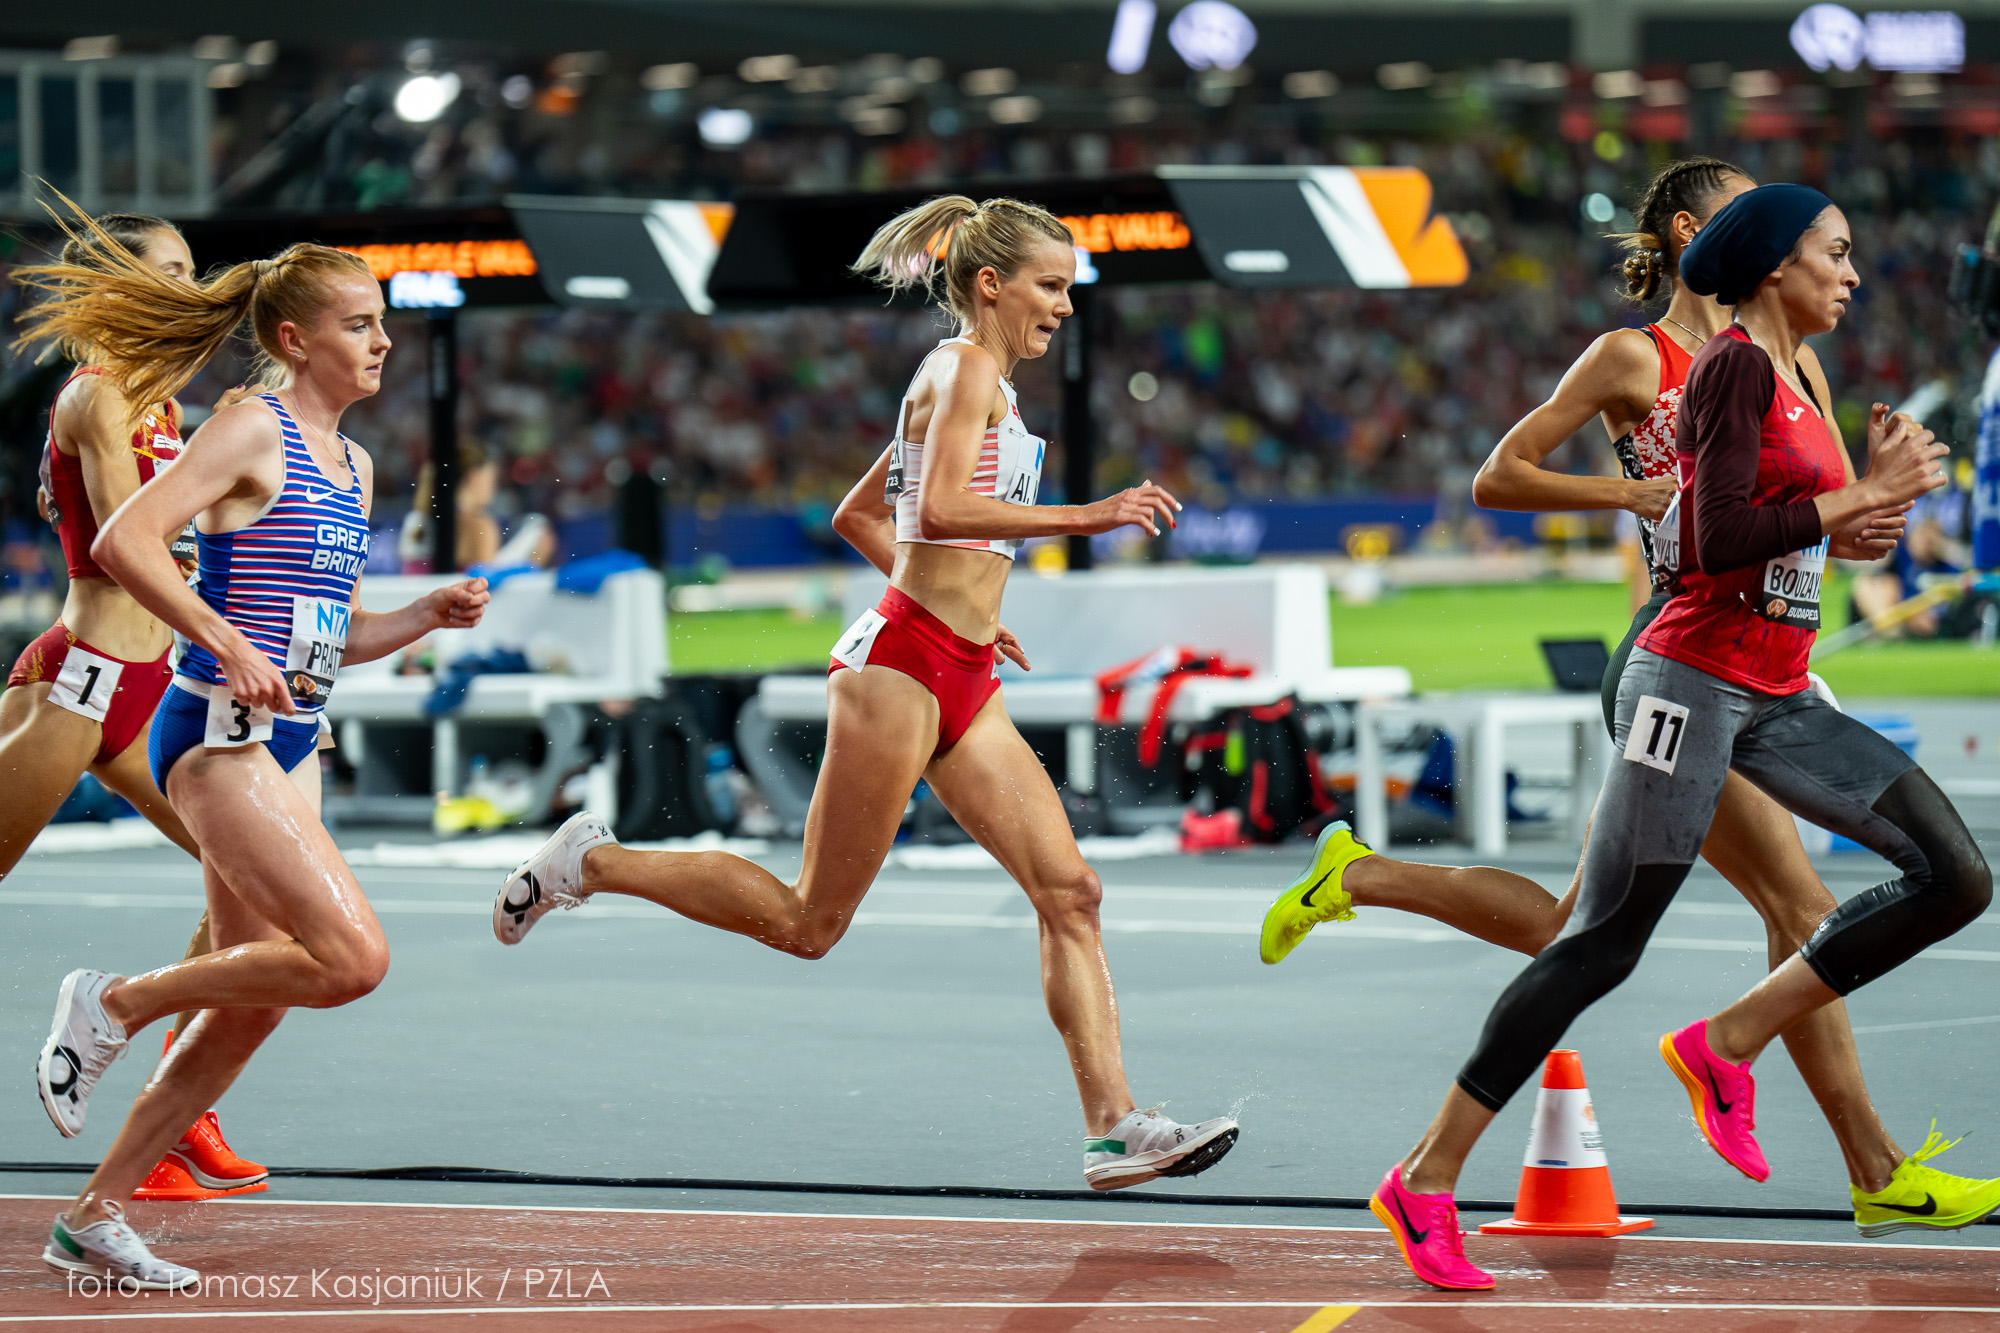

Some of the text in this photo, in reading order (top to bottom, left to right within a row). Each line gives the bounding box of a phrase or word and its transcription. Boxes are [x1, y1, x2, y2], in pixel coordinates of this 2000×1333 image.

[317, 523, 371, 555] GREA
[76, 665, 102, 706] 1
[226, 699, 251, 742] 3
[1645, 709, 1684, 762] 11
